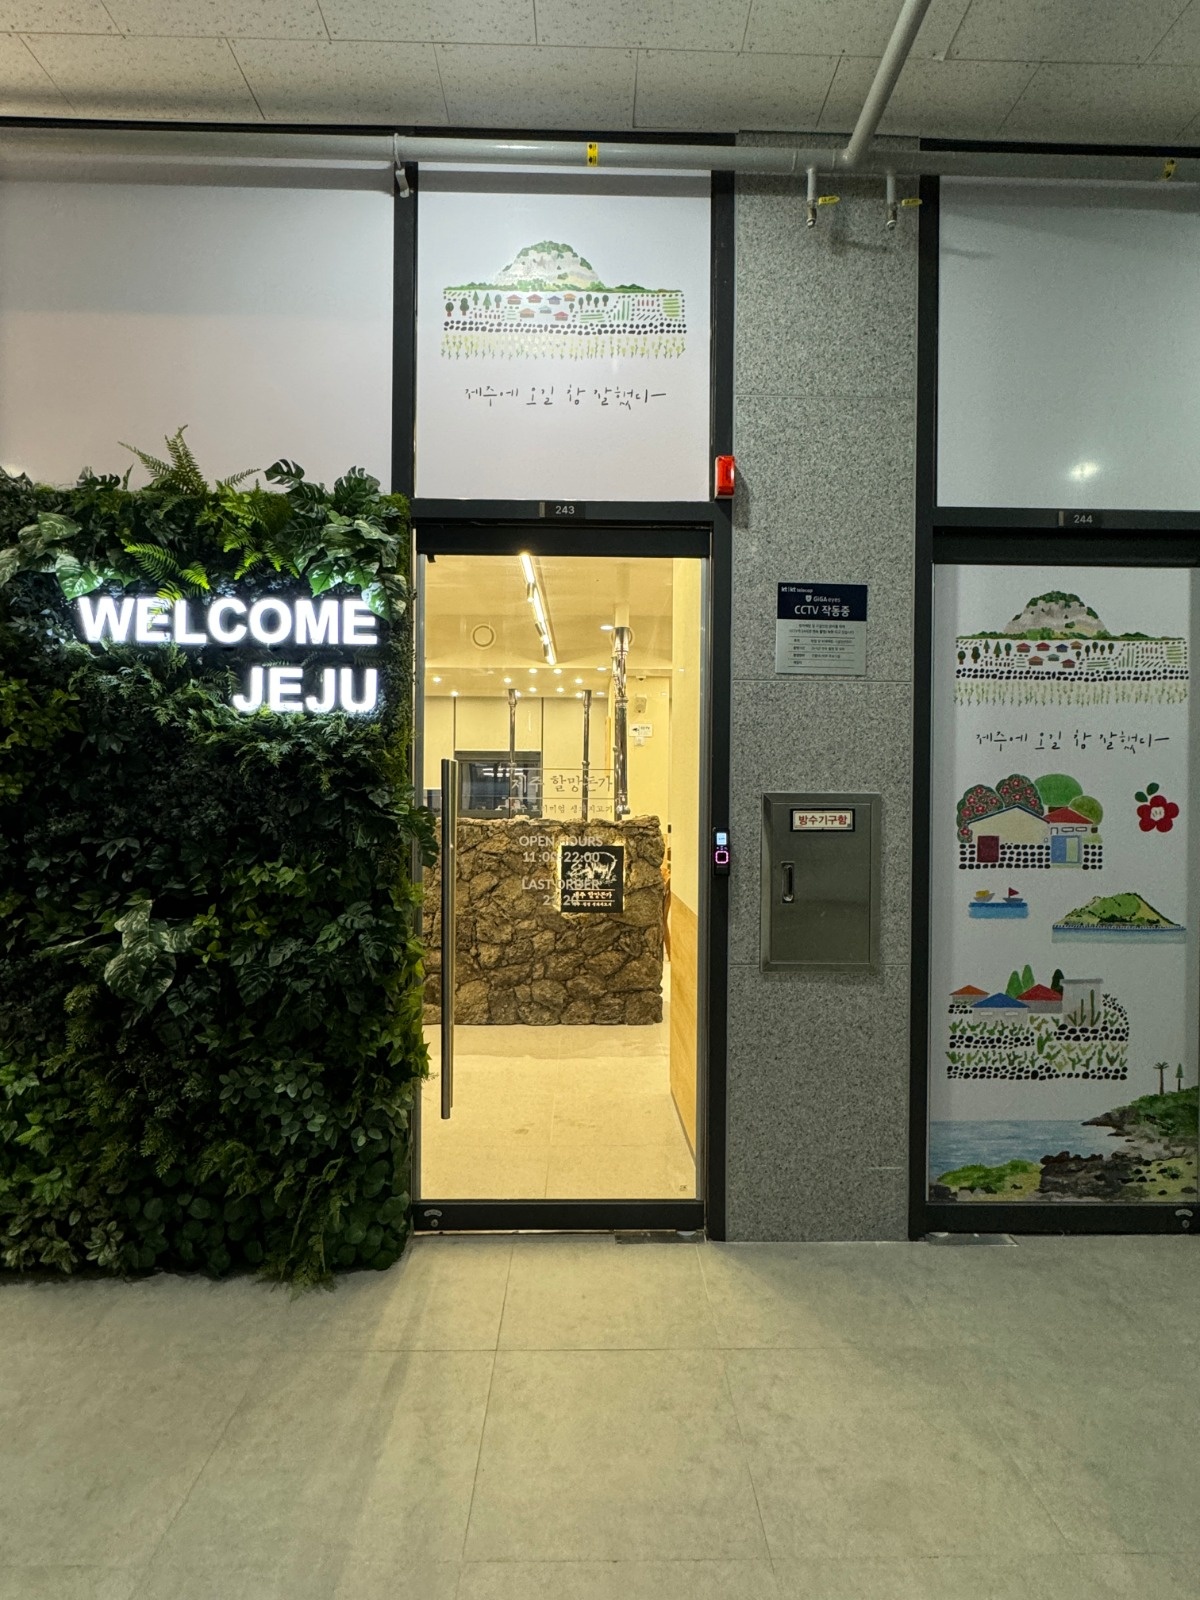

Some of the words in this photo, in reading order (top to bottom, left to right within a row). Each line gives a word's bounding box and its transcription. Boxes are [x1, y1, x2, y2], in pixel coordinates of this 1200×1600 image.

[465, 385, 519, 407] 제주에
[526, 386, 554, 406] 오길
[567, 384, 586, 406] 참
[555, 505, 575, 515] 243
[1073, 514, 1093, 524] 244
[794, 605, 819, 615] CCTV
[821, 605, 851, 617] 작동중
[78, 596, 378, 645] WELCOME
[232, 665, 379, 713] JEJU
[976, 730, 1028, 752] 제주에
[1034, 731, 1062, 750] 오길
[1073, 729, 1092, 750] 참
[798, 814, 848, 826] 방수기구함
[519, 835, 555, 847] OPEN
[521, 879, 554, 890] LAST
[557, 879, 601, 890] ORDER
